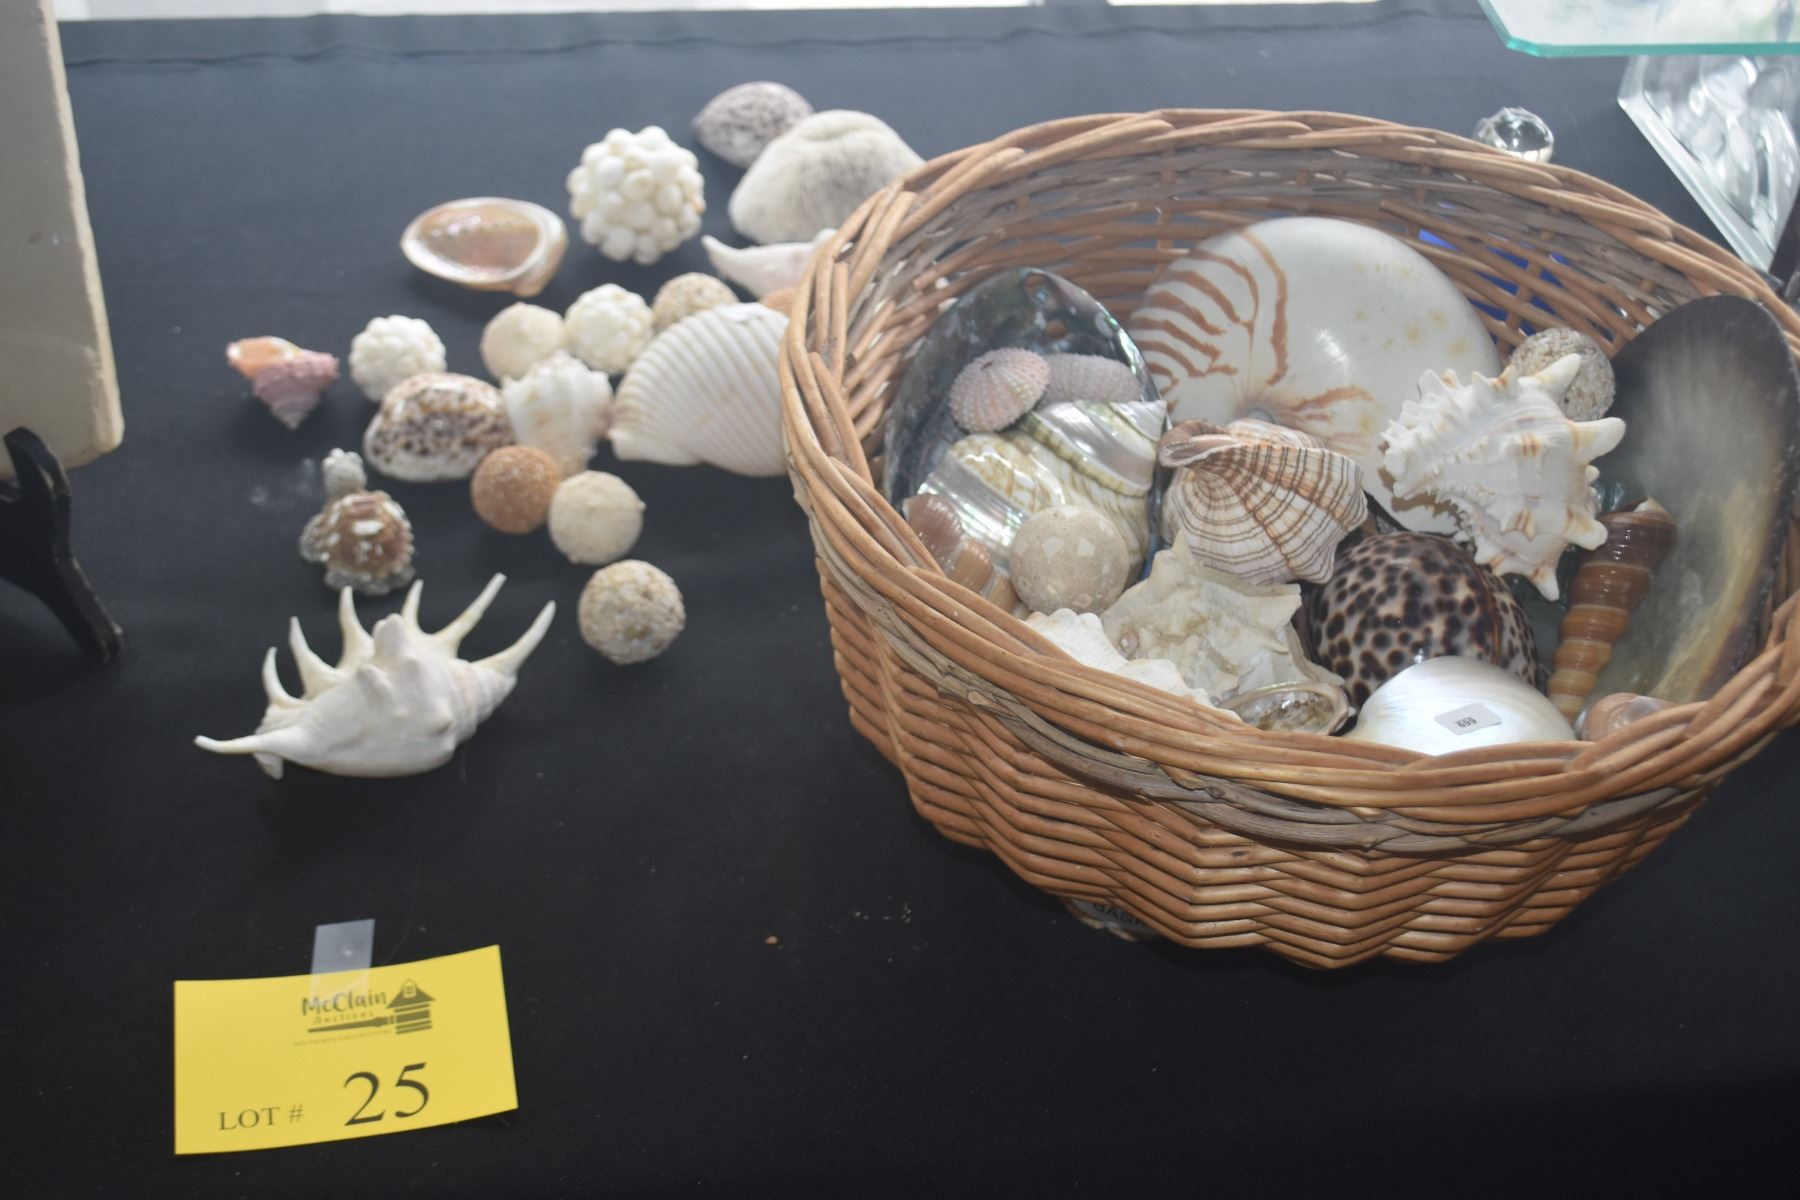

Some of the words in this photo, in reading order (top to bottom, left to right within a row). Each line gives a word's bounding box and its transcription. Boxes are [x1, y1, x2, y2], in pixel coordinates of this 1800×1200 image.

[301, 989, 388, 1016] McClain
[219, 1107, 281, 1131] LOT
[288, 1103, 304, 1124] #
[342, 1062, 431, 1127] 25
